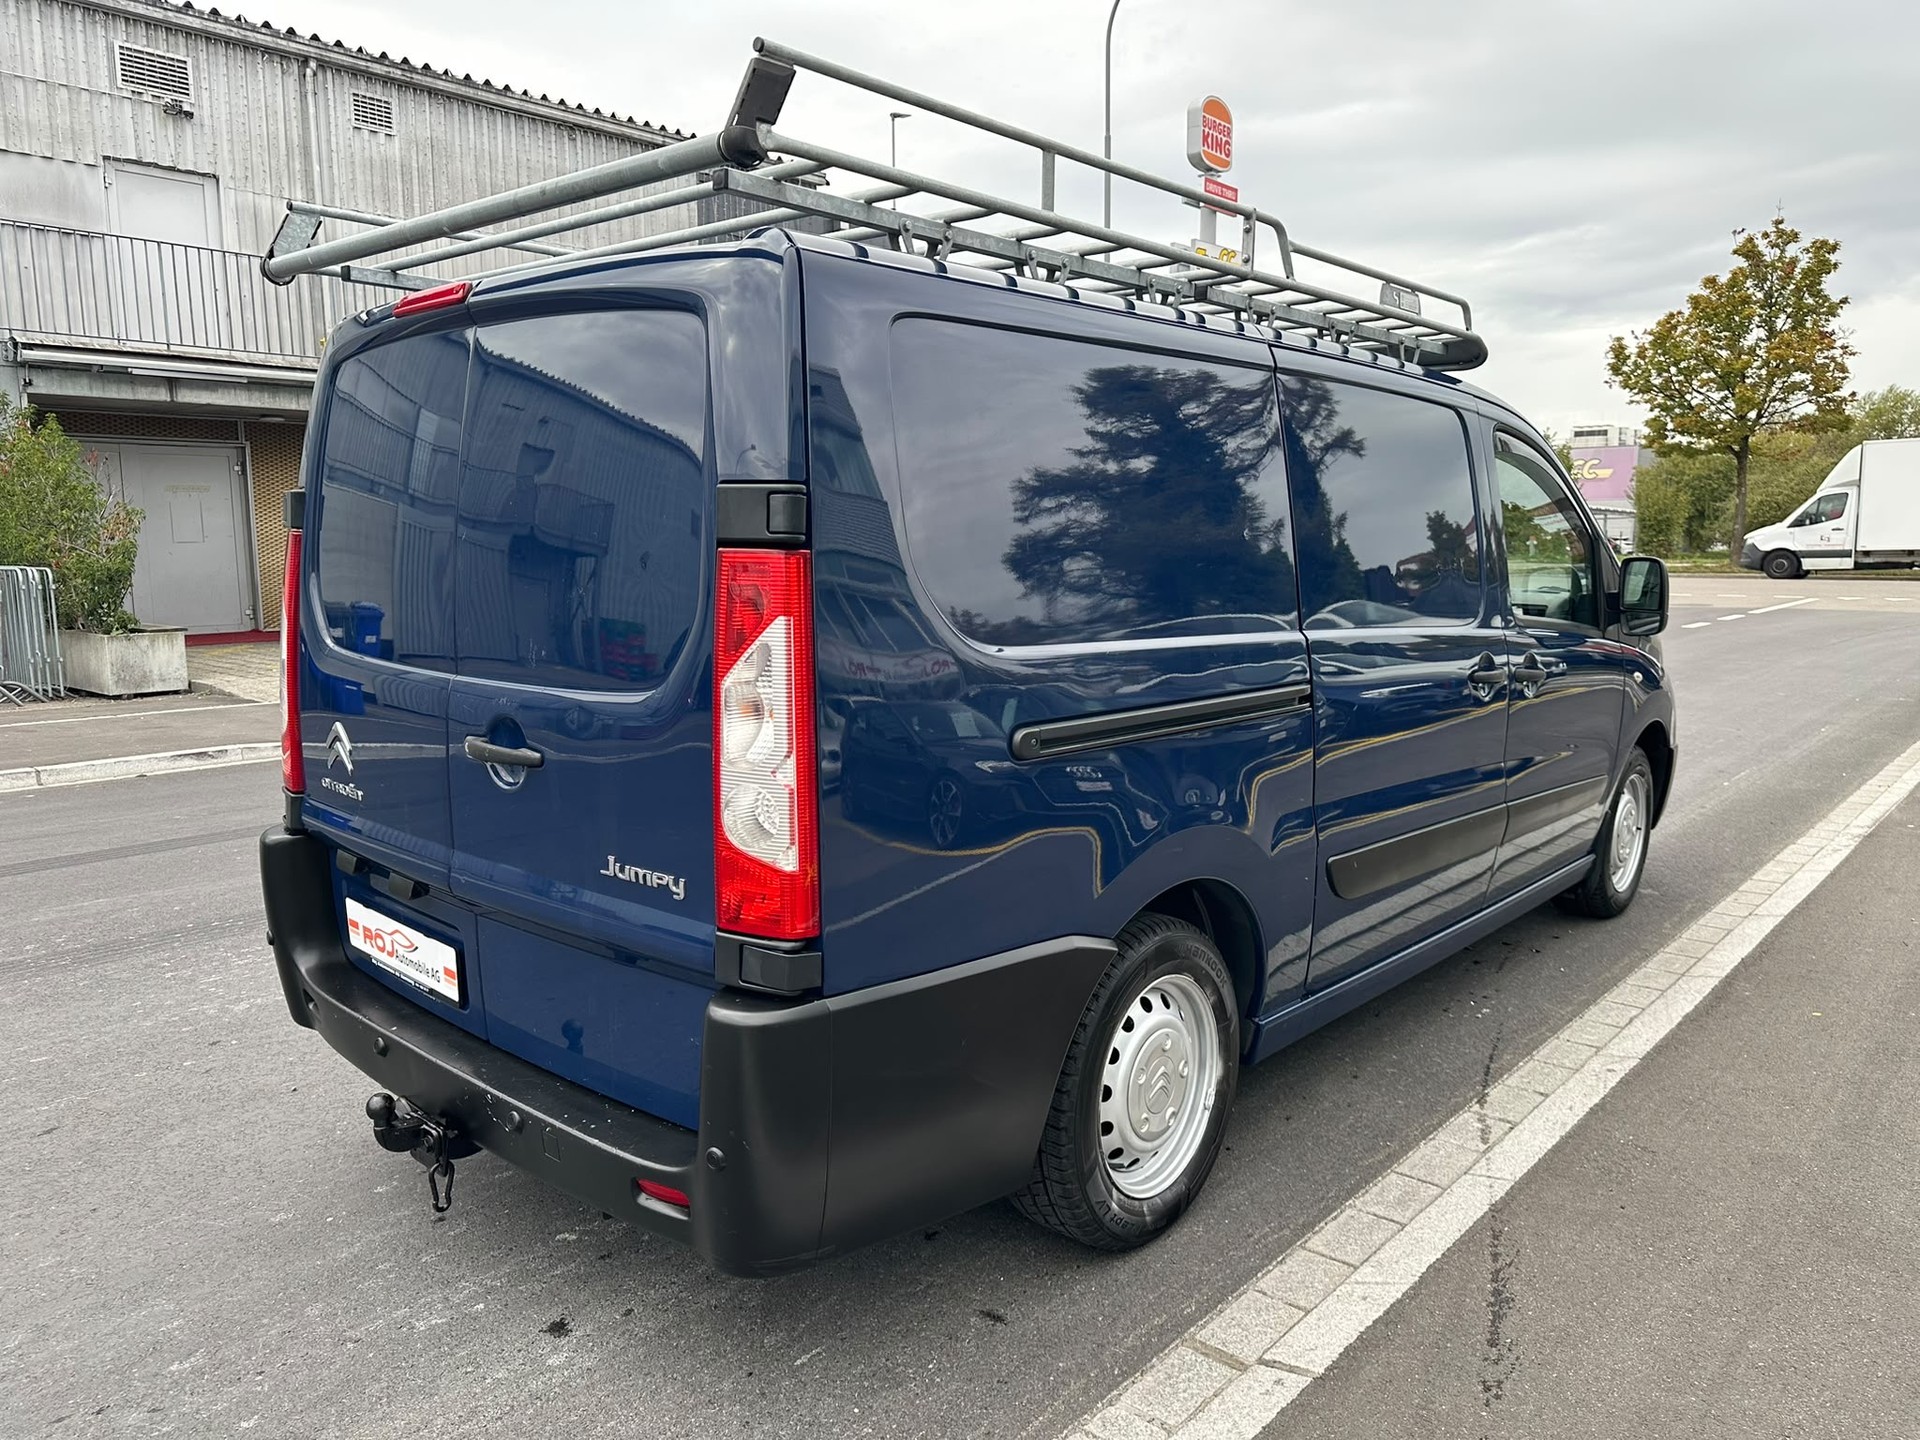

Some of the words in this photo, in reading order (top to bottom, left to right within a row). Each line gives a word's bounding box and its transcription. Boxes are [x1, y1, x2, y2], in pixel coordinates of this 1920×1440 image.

[1202, 115, 1231, 140] BURGER
[1202, 129, 1231, 158] KING
[1206, 181, 1222, 196] DRIVE
[1222, 186, 1236, 200] THRU
[600, 855, 685, 900] Jumpy
[362, 924, 395, 958] ROJ
[395, 949, 430, 978] Automobile
[430, 966, 441, 983] AG
